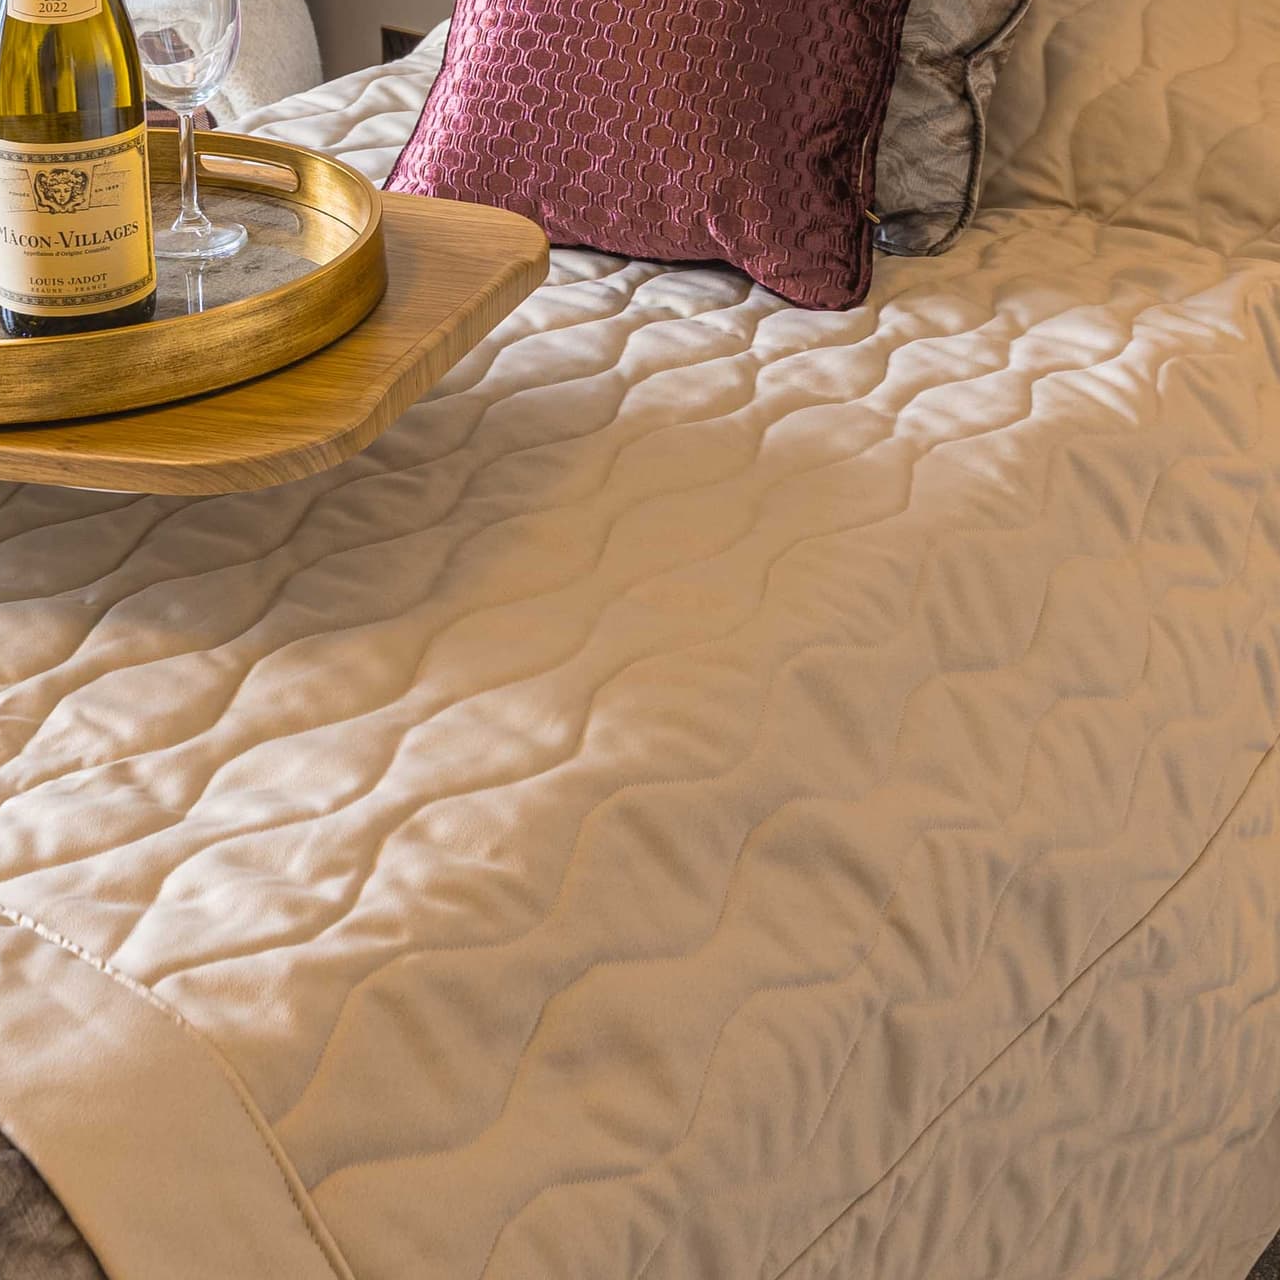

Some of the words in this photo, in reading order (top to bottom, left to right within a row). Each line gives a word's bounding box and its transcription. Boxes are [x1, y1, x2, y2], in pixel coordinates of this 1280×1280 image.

[39, 2, 68, 13] 2022
[30, 276, 65, 287] LOUIS
[67, 272, 108, 286] JADOT
